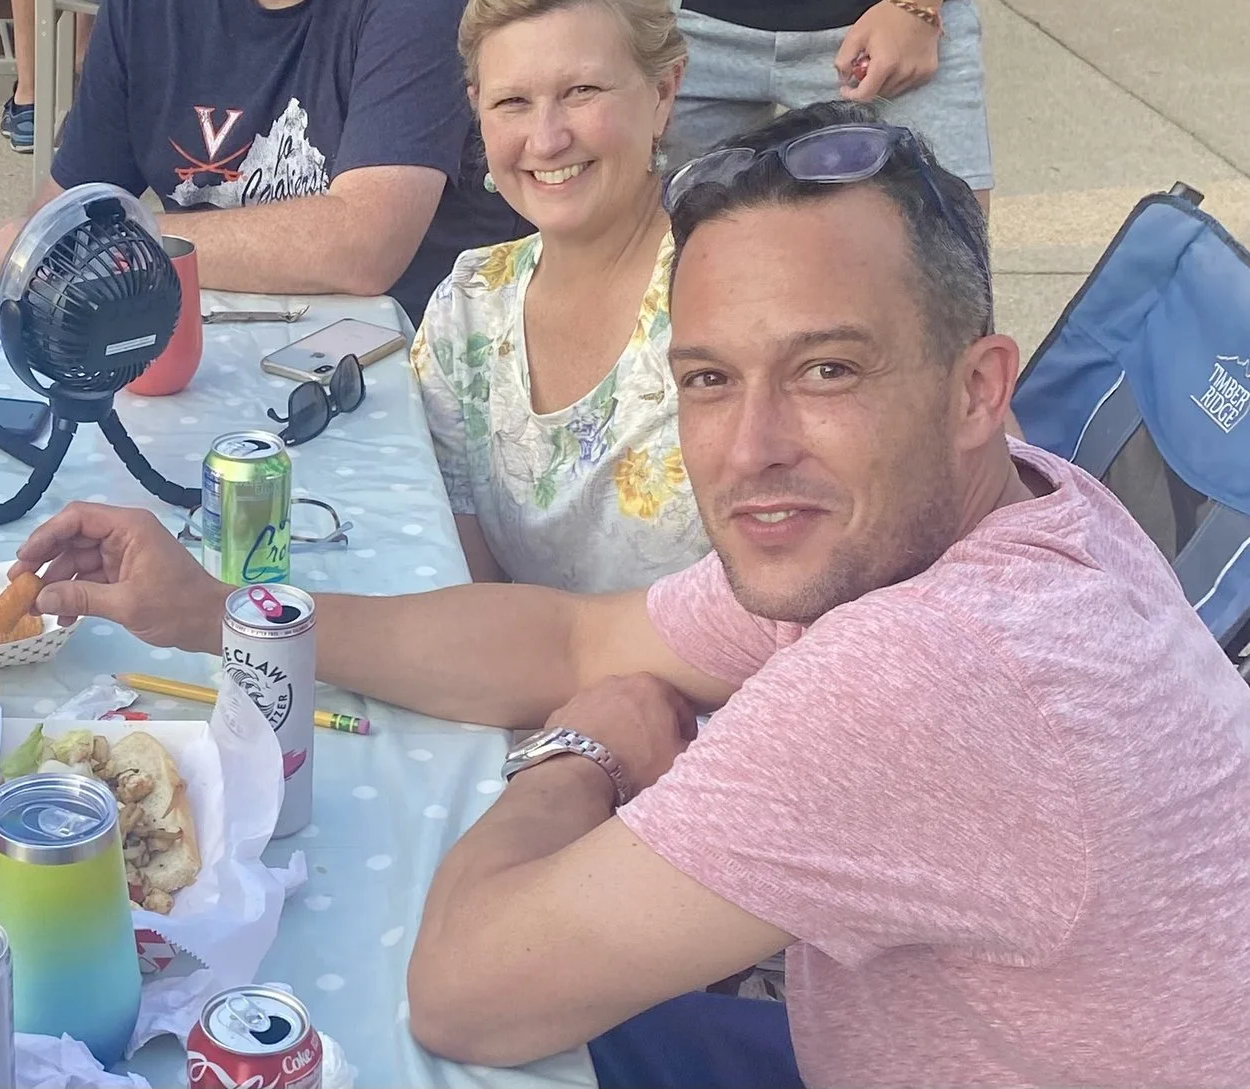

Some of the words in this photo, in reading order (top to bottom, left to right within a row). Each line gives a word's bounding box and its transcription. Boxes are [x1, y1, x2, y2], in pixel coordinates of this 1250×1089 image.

[193, 104, 244, 160] V
[1200, 385, 1239, 428] RIDGE
[1209, 362, 1250, 412] TIMBER
[234, 649, 288, 684] CLAW
[269, 694, 288, 725] TZER
[282, 1049, 312, 1074] Coke
